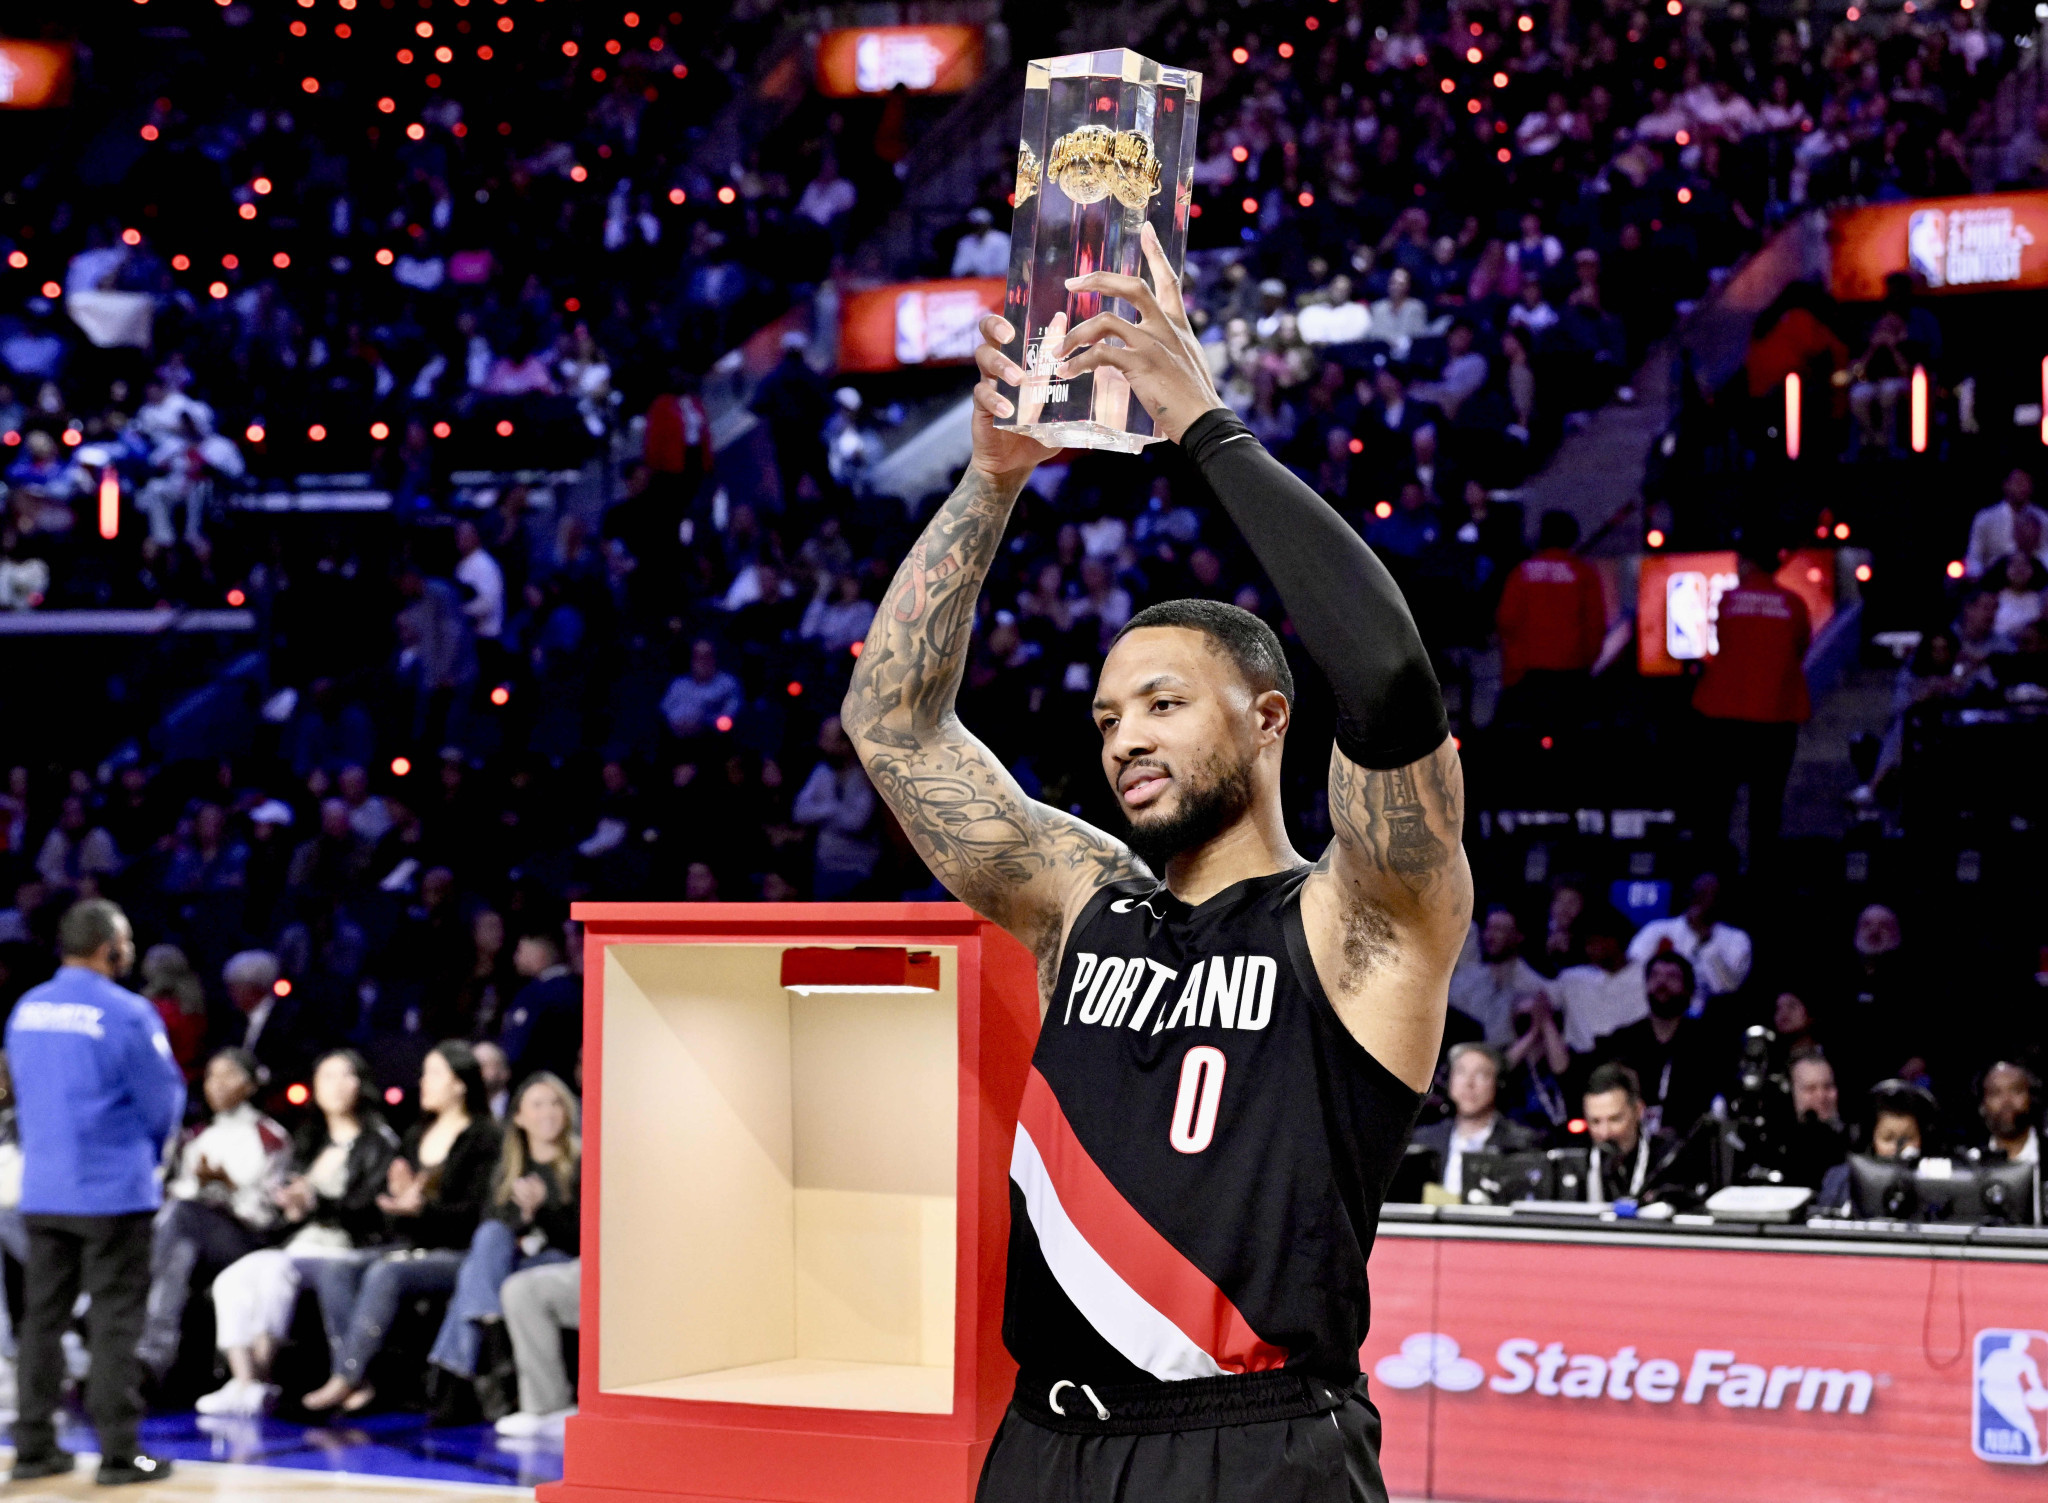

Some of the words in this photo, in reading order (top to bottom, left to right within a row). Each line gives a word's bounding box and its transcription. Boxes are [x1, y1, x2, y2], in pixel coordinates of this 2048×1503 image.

[1064, 953, 1277, 1037] PORTLAND
[1170, 1045, 1227, 1155] 0
[1984, 1427, 2024, 1454] NBA
